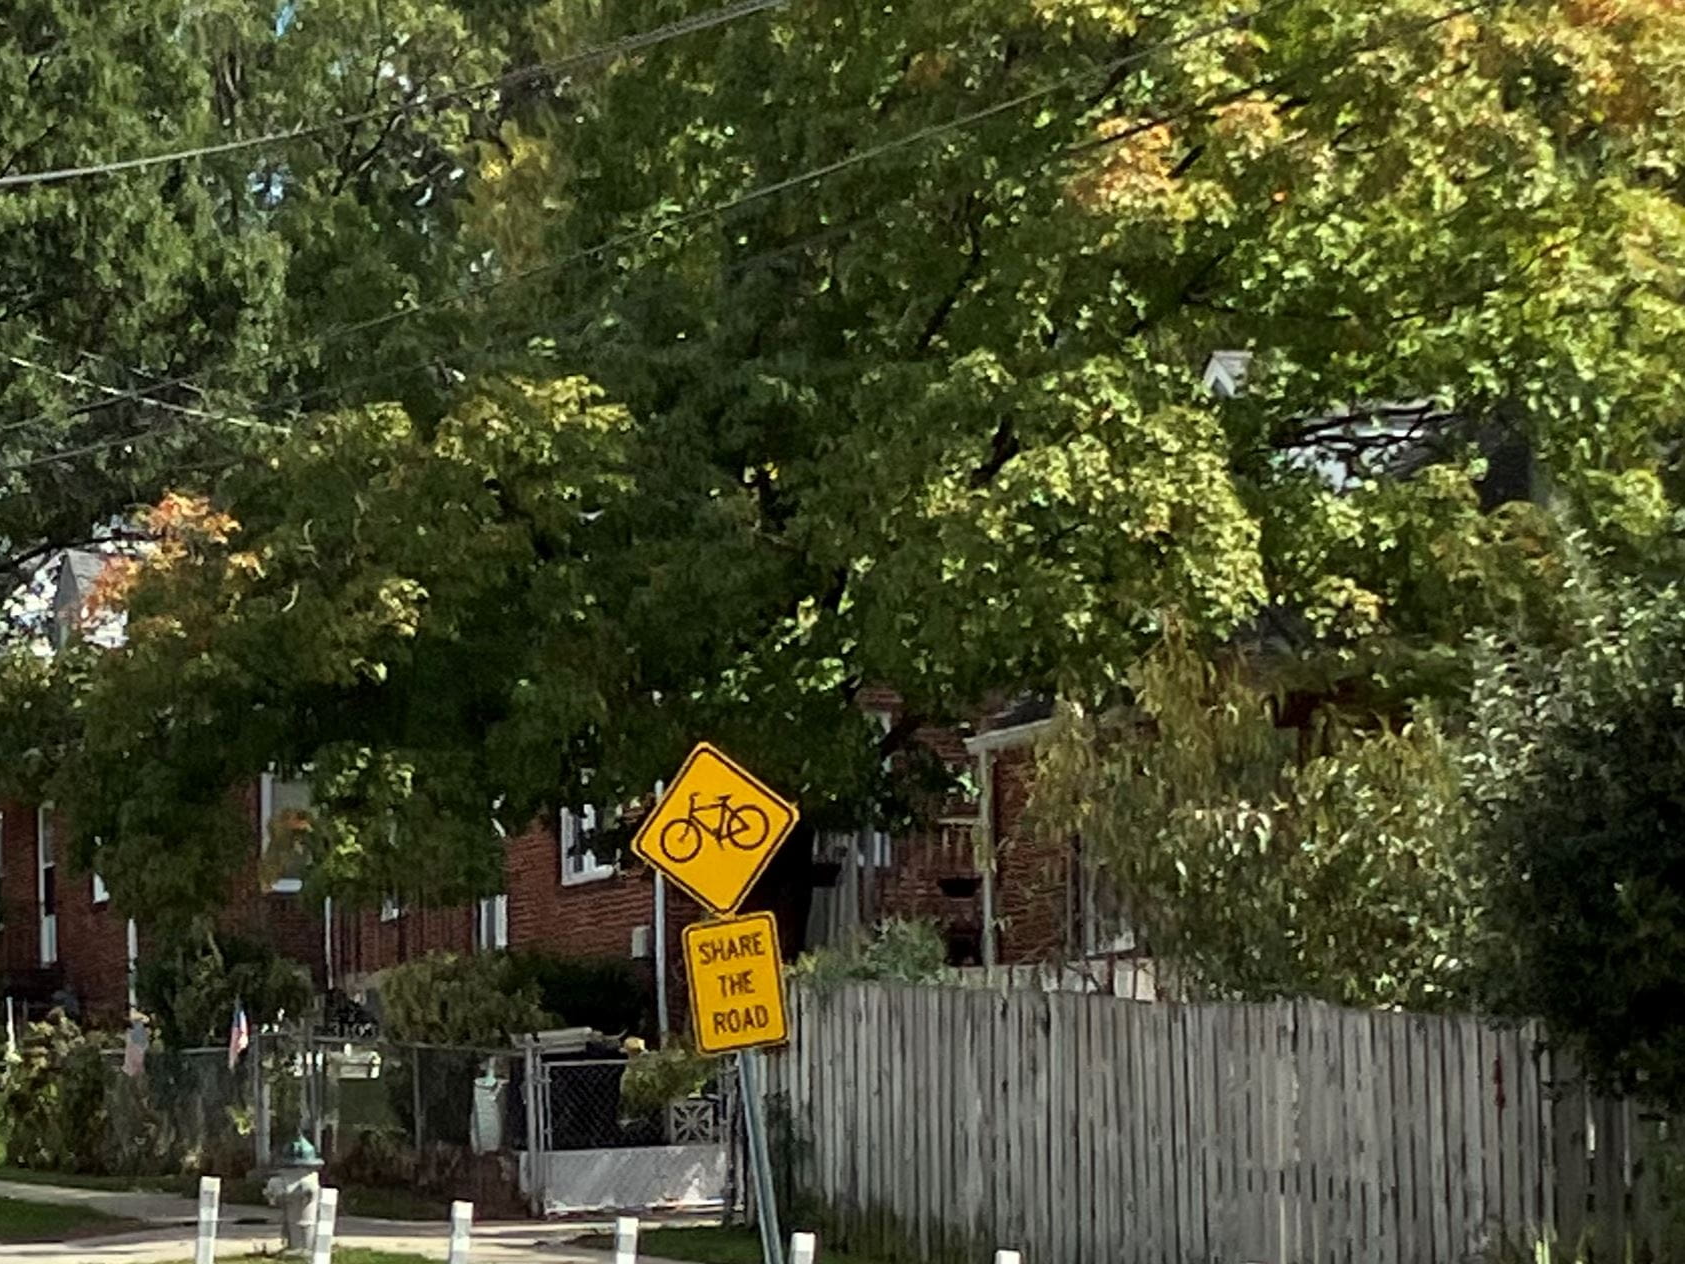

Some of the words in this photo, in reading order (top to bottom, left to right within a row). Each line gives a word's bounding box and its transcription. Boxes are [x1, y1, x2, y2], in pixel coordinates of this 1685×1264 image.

[697, 931, 766, 966] SHARE
[717, 968, 756, 998] THE
[712, 1004, 770, 1035] ROAD
